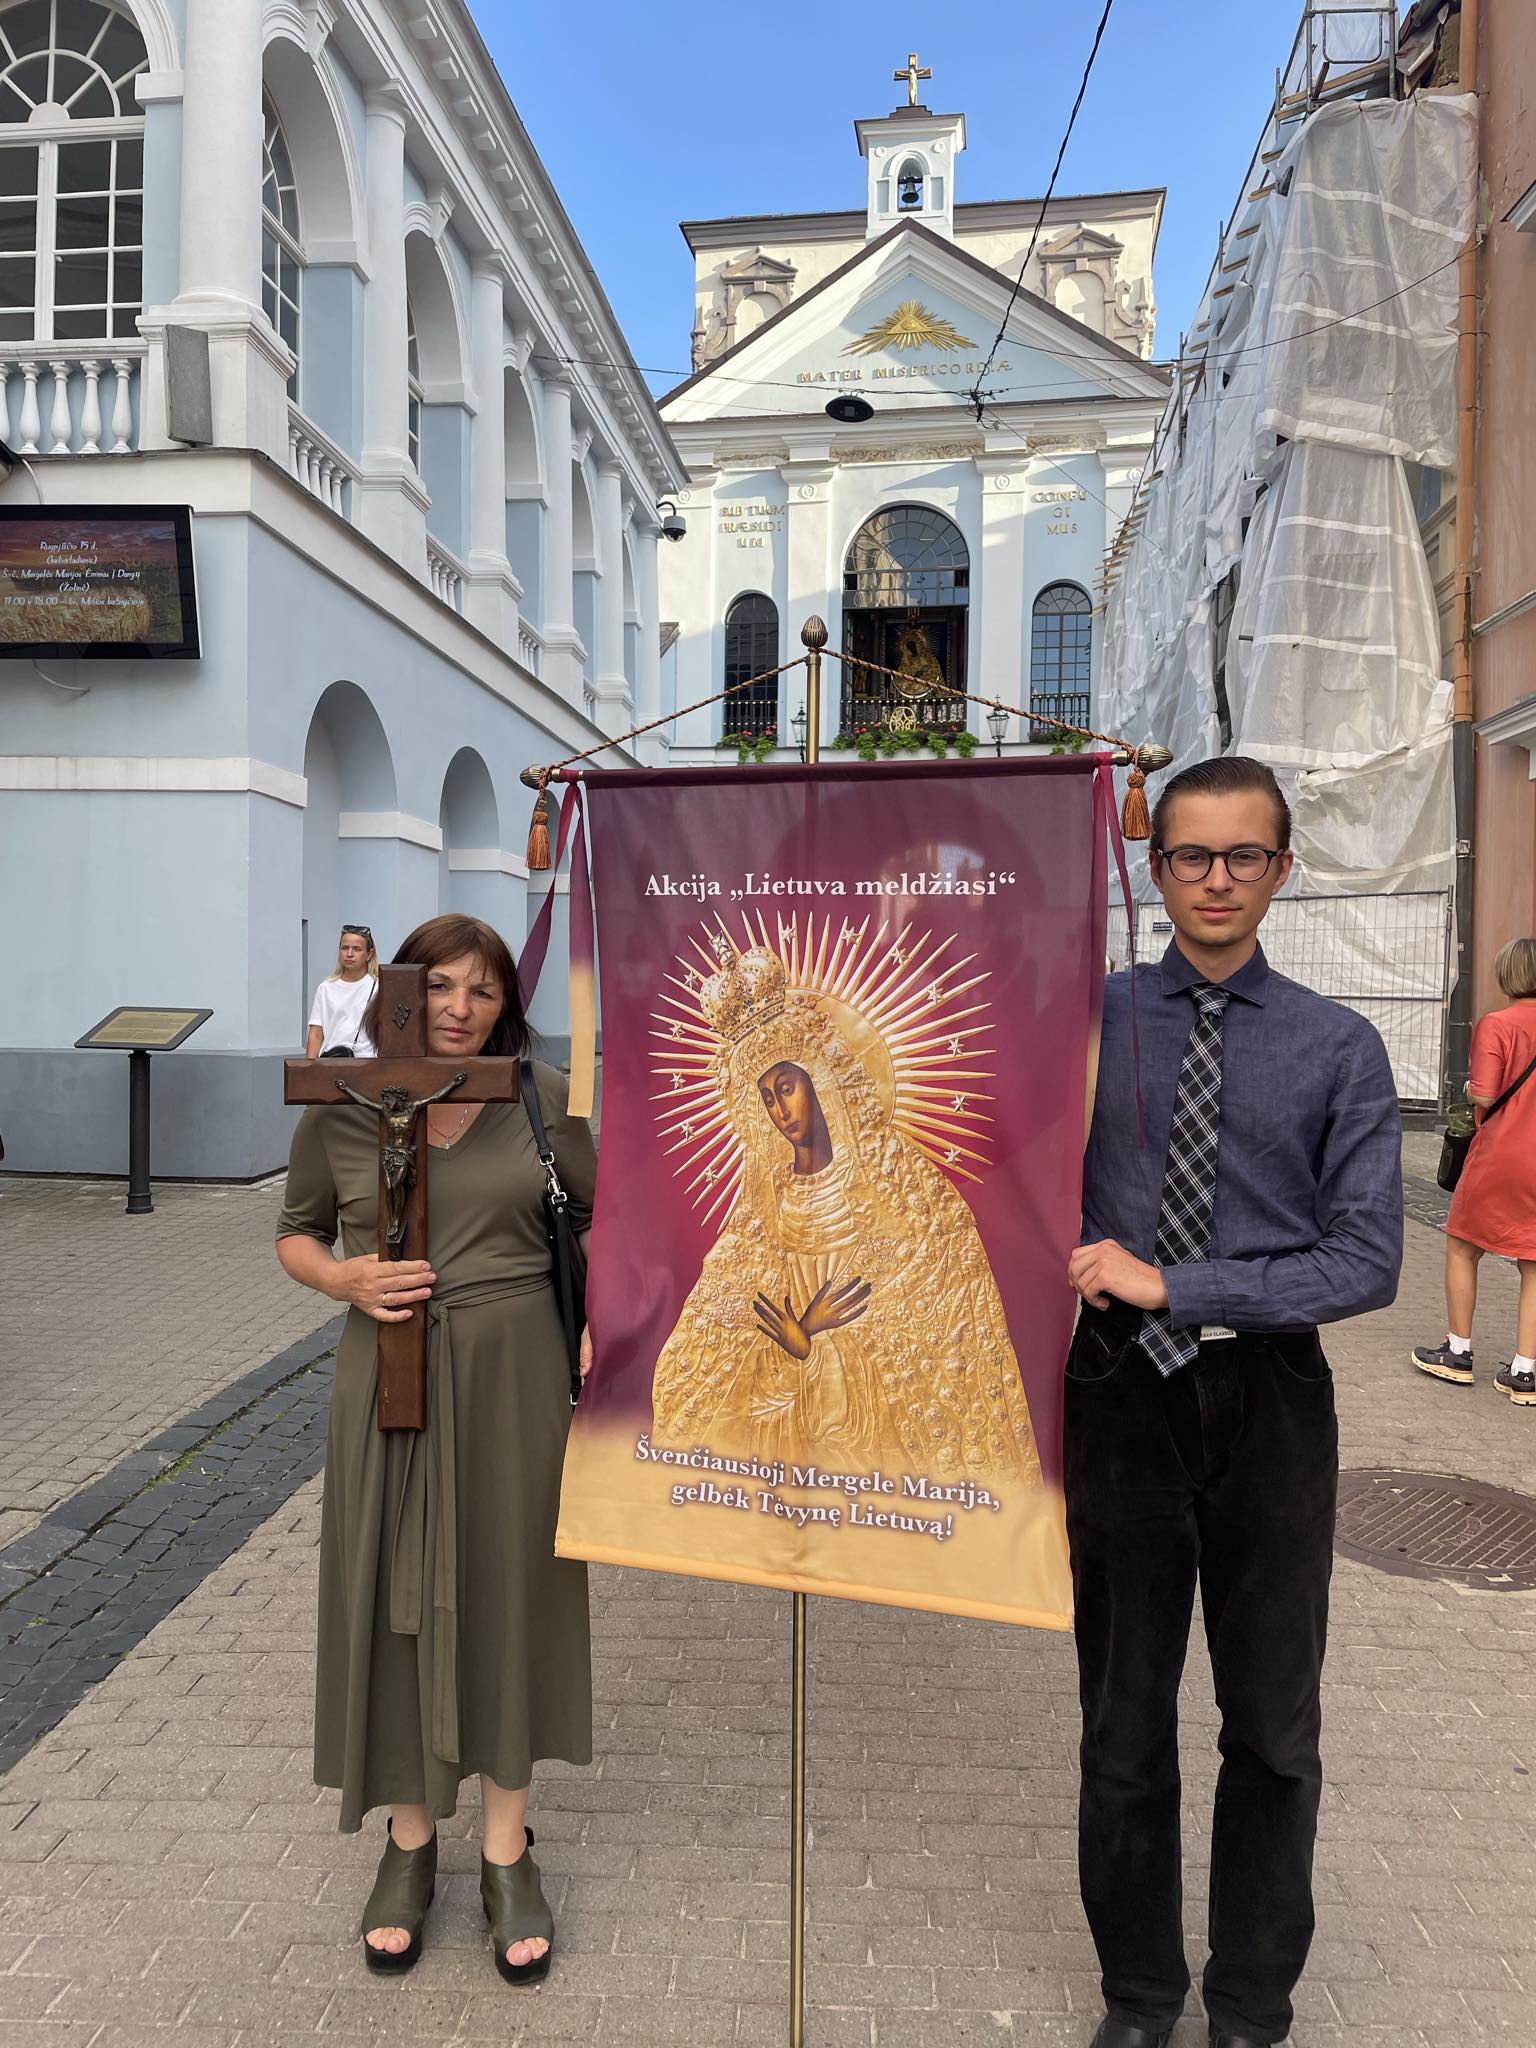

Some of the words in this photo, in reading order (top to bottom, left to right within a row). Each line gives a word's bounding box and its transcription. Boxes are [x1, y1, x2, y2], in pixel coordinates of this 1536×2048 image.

[798, 368, 864, 384] MATER
[1032, 490, 1088, 503] CONFU
[720, 505, 743, 517] SUB
[1052, 506, 1072, 519] GI
[1046, 522, 1078, 536] MUS
[80, 541, 89, 550] 15
[90, 541, 99, 550] d.
[20, 568, 53, 581] Mergelės
[55, 568, 82, 581] Marijos
[117, 568, 141, 581] Dangų
[59, 581, 90, 593] (Žolinė)
[644, 873, 722, 902] Akcija
[730, 872, 847, 901] „Lietuva
[854, 871, 1017, 897] meldžiasi“
[635, 1434, 785, 1487] Švenčiausioji
[791, 1465, 894, 1497] Mergele
[901, 1474, 1001, 1511] Marija,
[671, 1480, 750, 1510] gelbėk
[757, 1490, 842, 1528] Tėvynę
[847, 1502, 954, 1541] Lietuvą!
